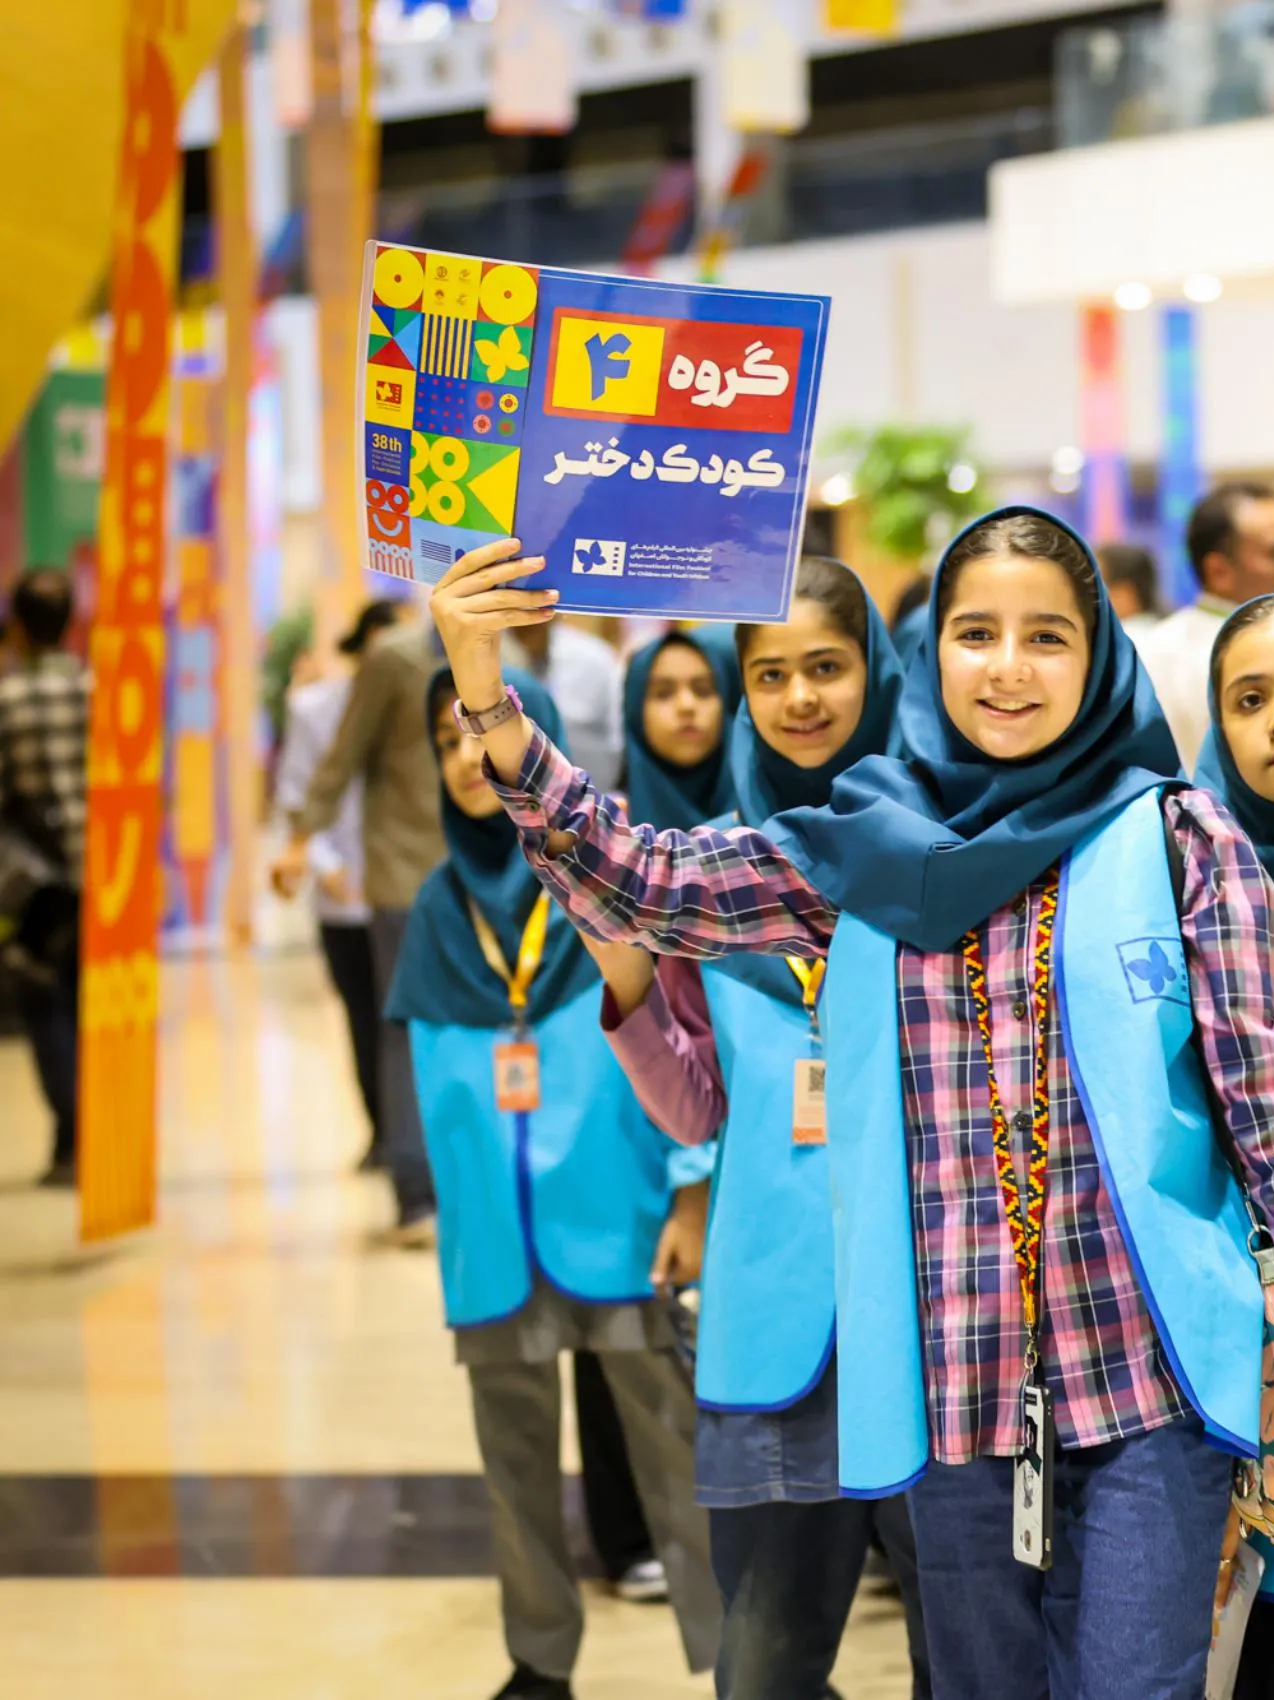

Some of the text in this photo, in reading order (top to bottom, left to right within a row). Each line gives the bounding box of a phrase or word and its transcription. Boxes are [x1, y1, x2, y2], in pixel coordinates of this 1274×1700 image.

[584, 332, 790, 408] گروه ۴
[372, 433, 403, 453] 38th
[543, 436, 786, 497] کودک دختر
